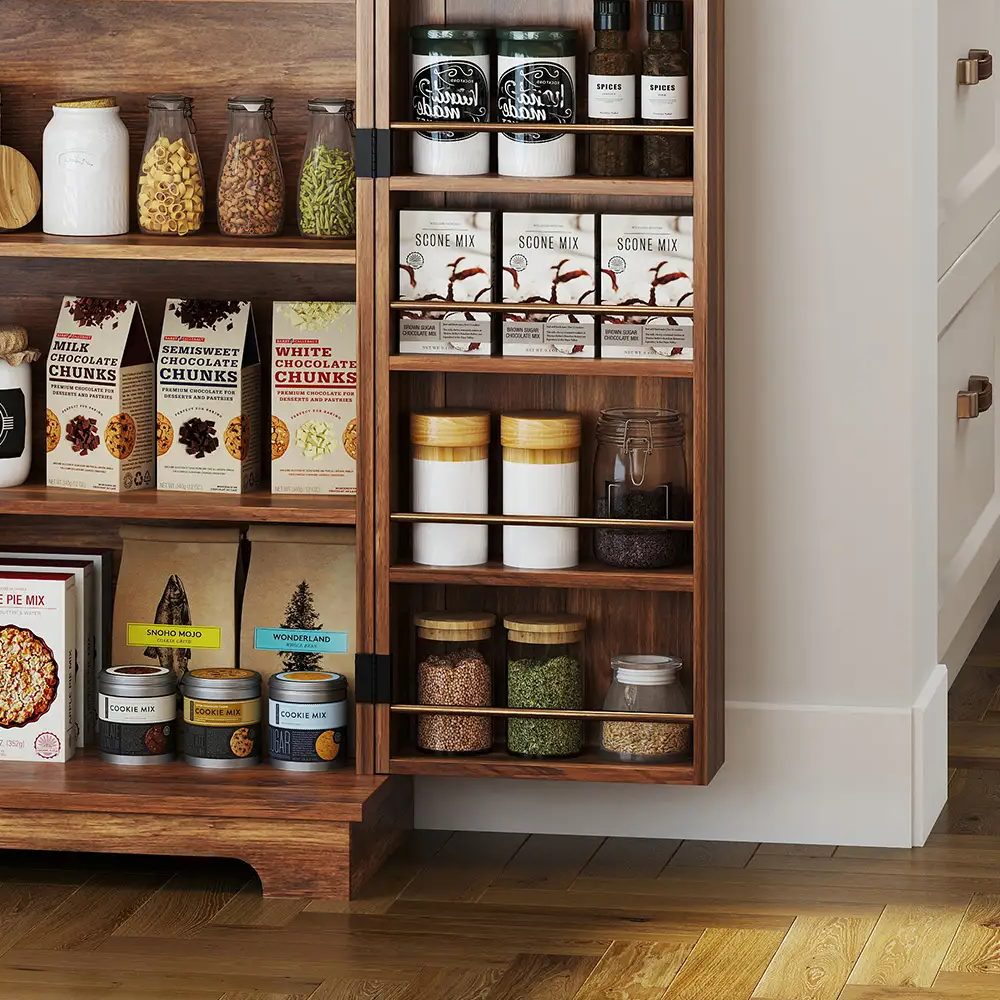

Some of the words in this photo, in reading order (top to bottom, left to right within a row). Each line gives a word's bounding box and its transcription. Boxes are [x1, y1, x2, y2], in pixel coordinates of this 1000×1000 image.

[596, 83, 622, 91] SPICES
[650, 84, 676, 92] SPICES
[415, 233, 451, 247] SCONE
[456, 234, 475, 248] MIX
[519, 235, 554, 249] SCONE
[560, 236, 579, 250] MIX
[617, 238, 653, 251] SCONE
[658, 238, 678, 252] MIX
[53, 341, 90, 353] MILK
[162, 345, 239, 357] SEMISWEET
[275, 347, 332, 357] WHITE
[50, 354, 118, 367] CHOCOLATE
[160, 357, 238, 368] CHOCOLATE
[275, 360, 356, 369] CHOCOLATE
[49, 365, 117, 381] CHUNKS
[160, 368, 238, 383] CHUNKS
[275, 371, 356, 383] CHUNKS
[6, 594, 22, 605] PIE
[25, 595, 45, 606] MIX
[146, 629, 177, 638] SNOHO
[178, 630, 202, 638] MOJO
[273, 633, 331, 643] WONDERLAND
[195, 708, 224, 716] COOKIE
[280, 711, 309, 719] COOKIE
[6, 740, 25, 748] (352g)
